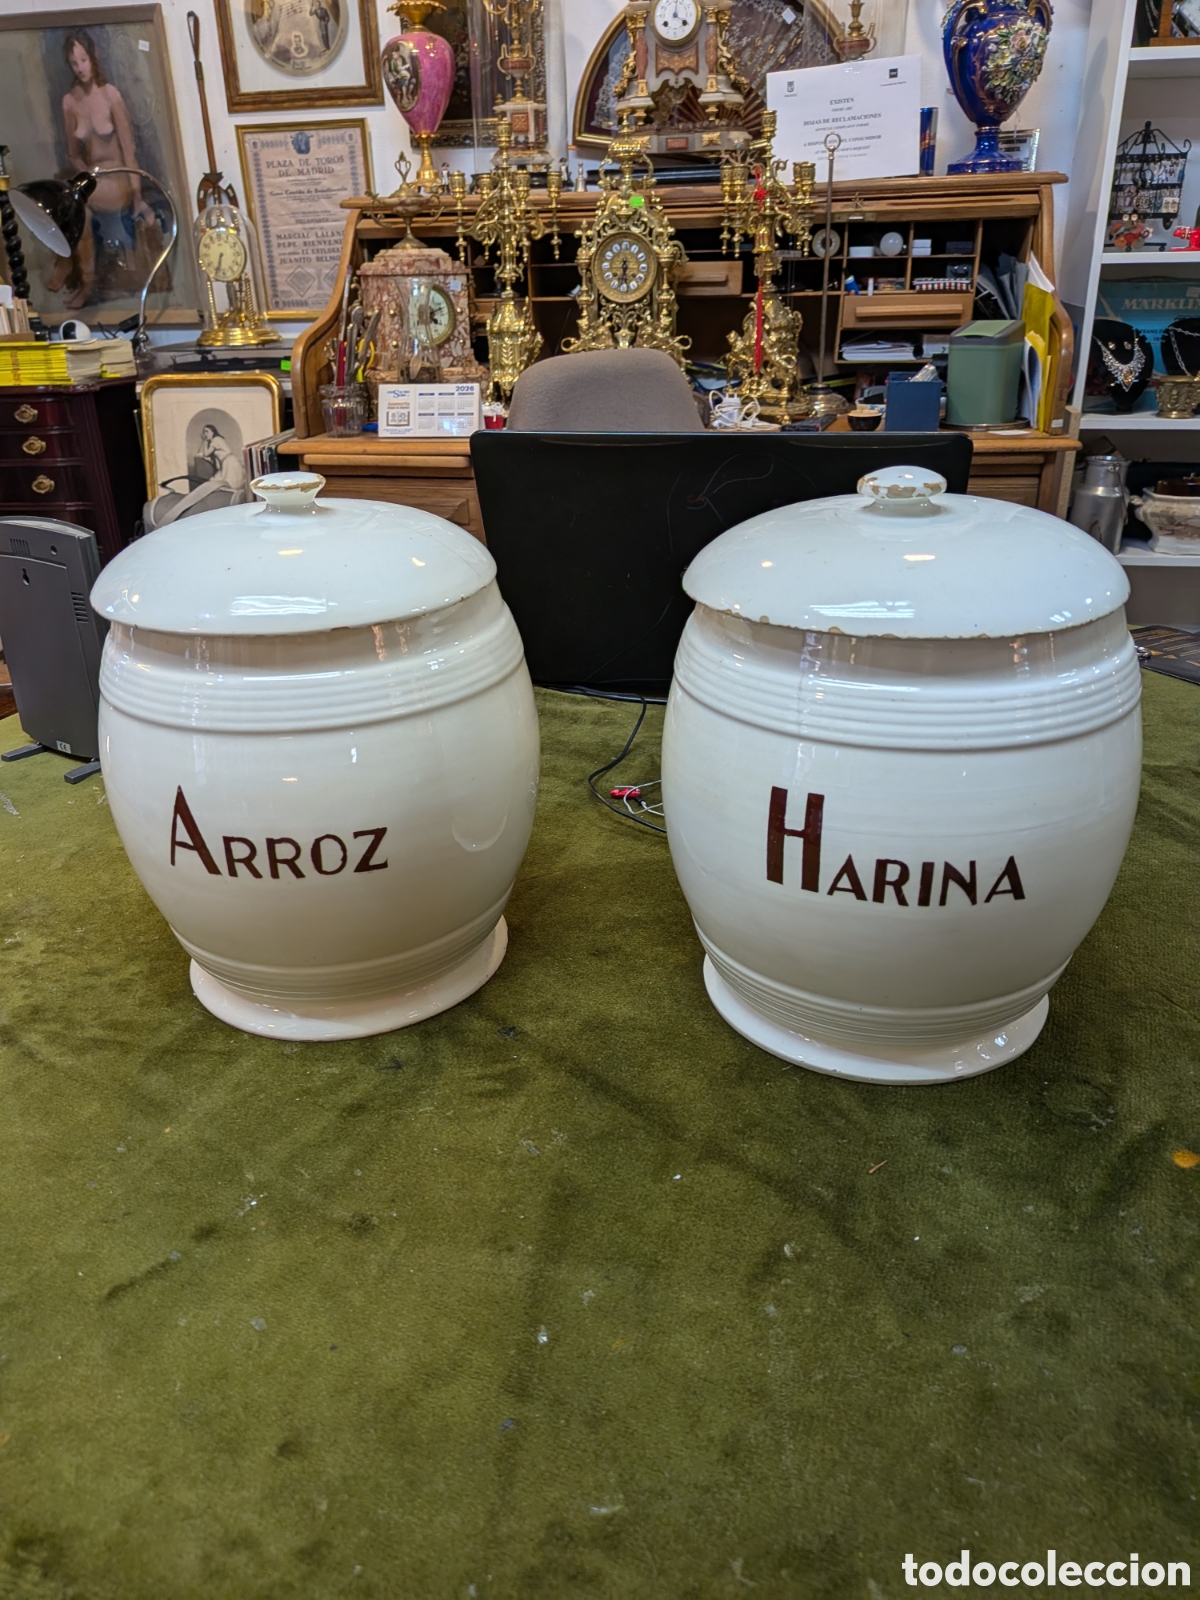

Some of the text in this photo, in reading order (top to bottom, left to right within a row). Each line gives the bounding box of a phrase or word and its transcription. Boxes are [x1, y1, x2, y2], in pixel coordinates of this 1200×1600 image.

[830, 97, 854, 105] EXISTEN
[831, 113, 882, 123] RECLAMACIONES
[265, 155, 345, 169] PLAZA DE TOROS
[278, 166, 335, 177] DE MADRID
